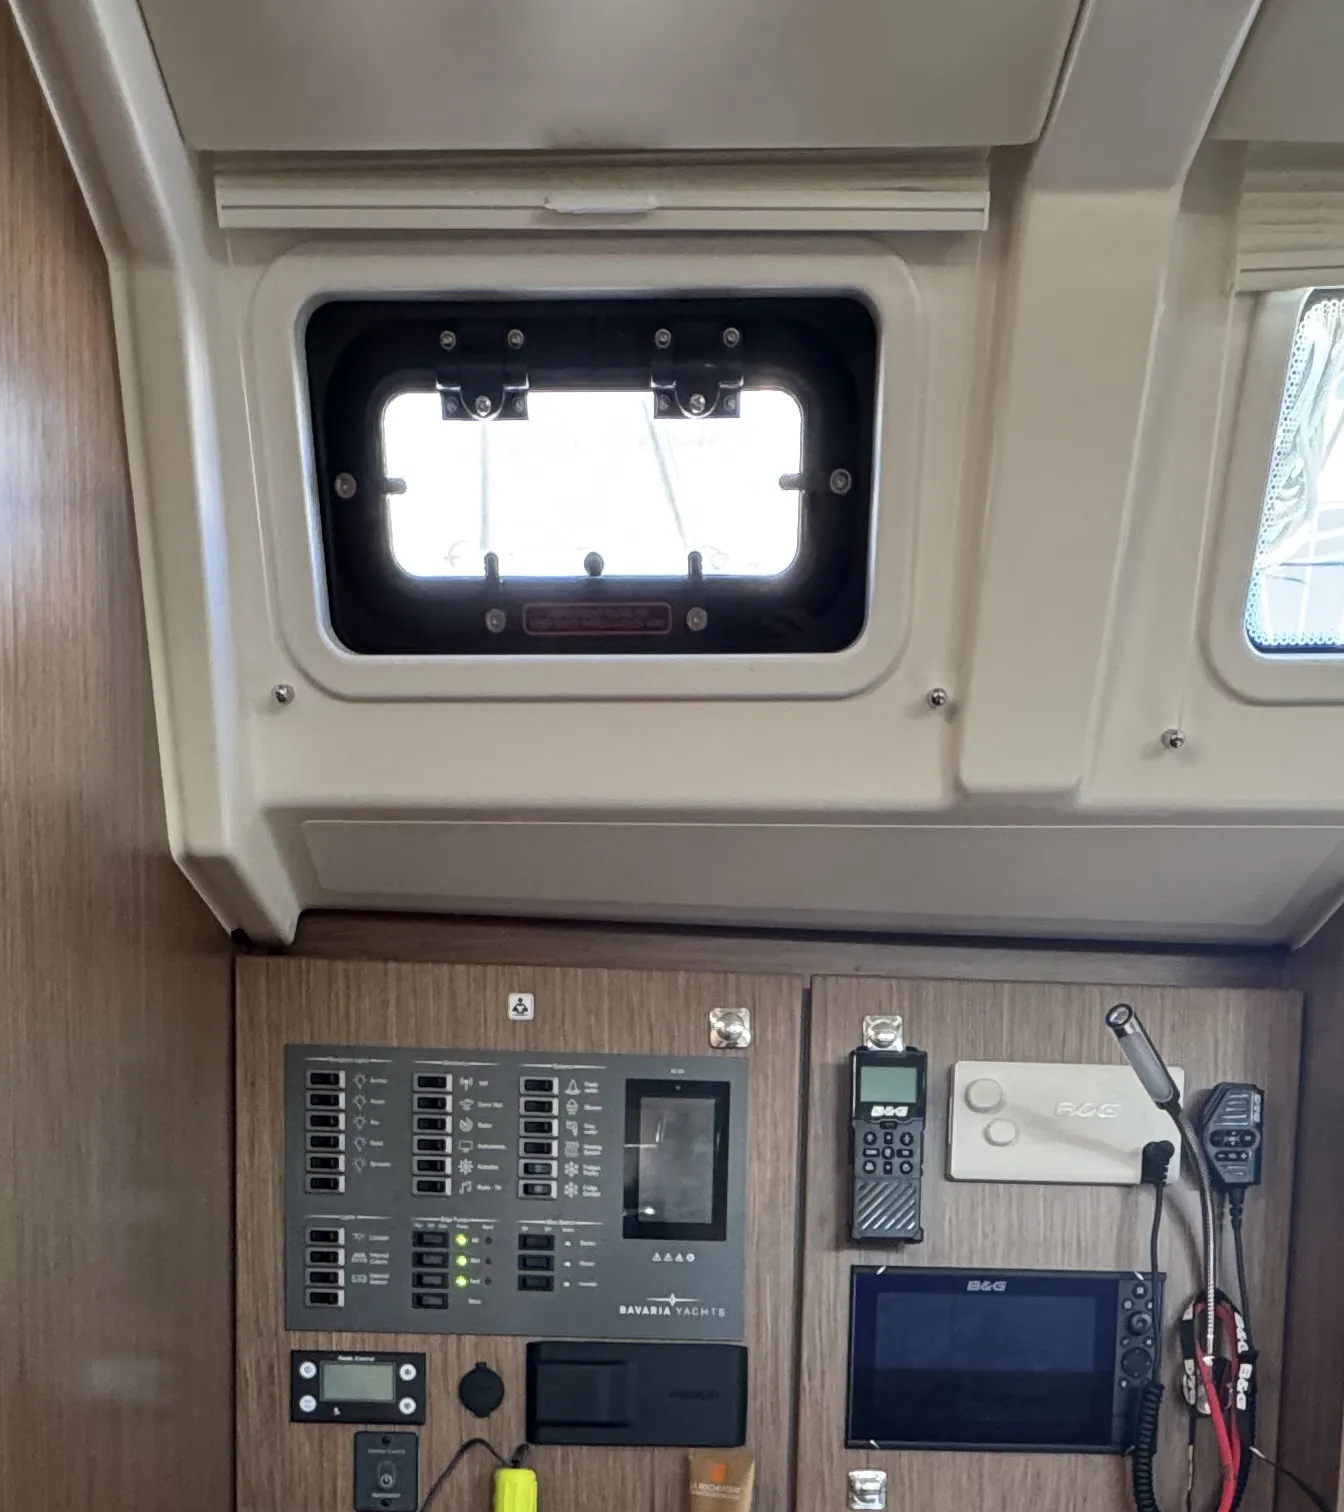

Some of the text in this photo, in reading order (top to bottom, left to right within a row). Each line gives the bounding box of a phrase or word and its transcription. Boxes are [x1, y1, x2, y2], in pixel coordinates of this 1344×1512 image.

[870, 1105, 910, 1118] B&G
[966, 1280, 1008, 1292] B&G
[619, 1305, 726, 1317] BAVARIA YACHTS
[1236, 1363, 1253, 1411] B&G
